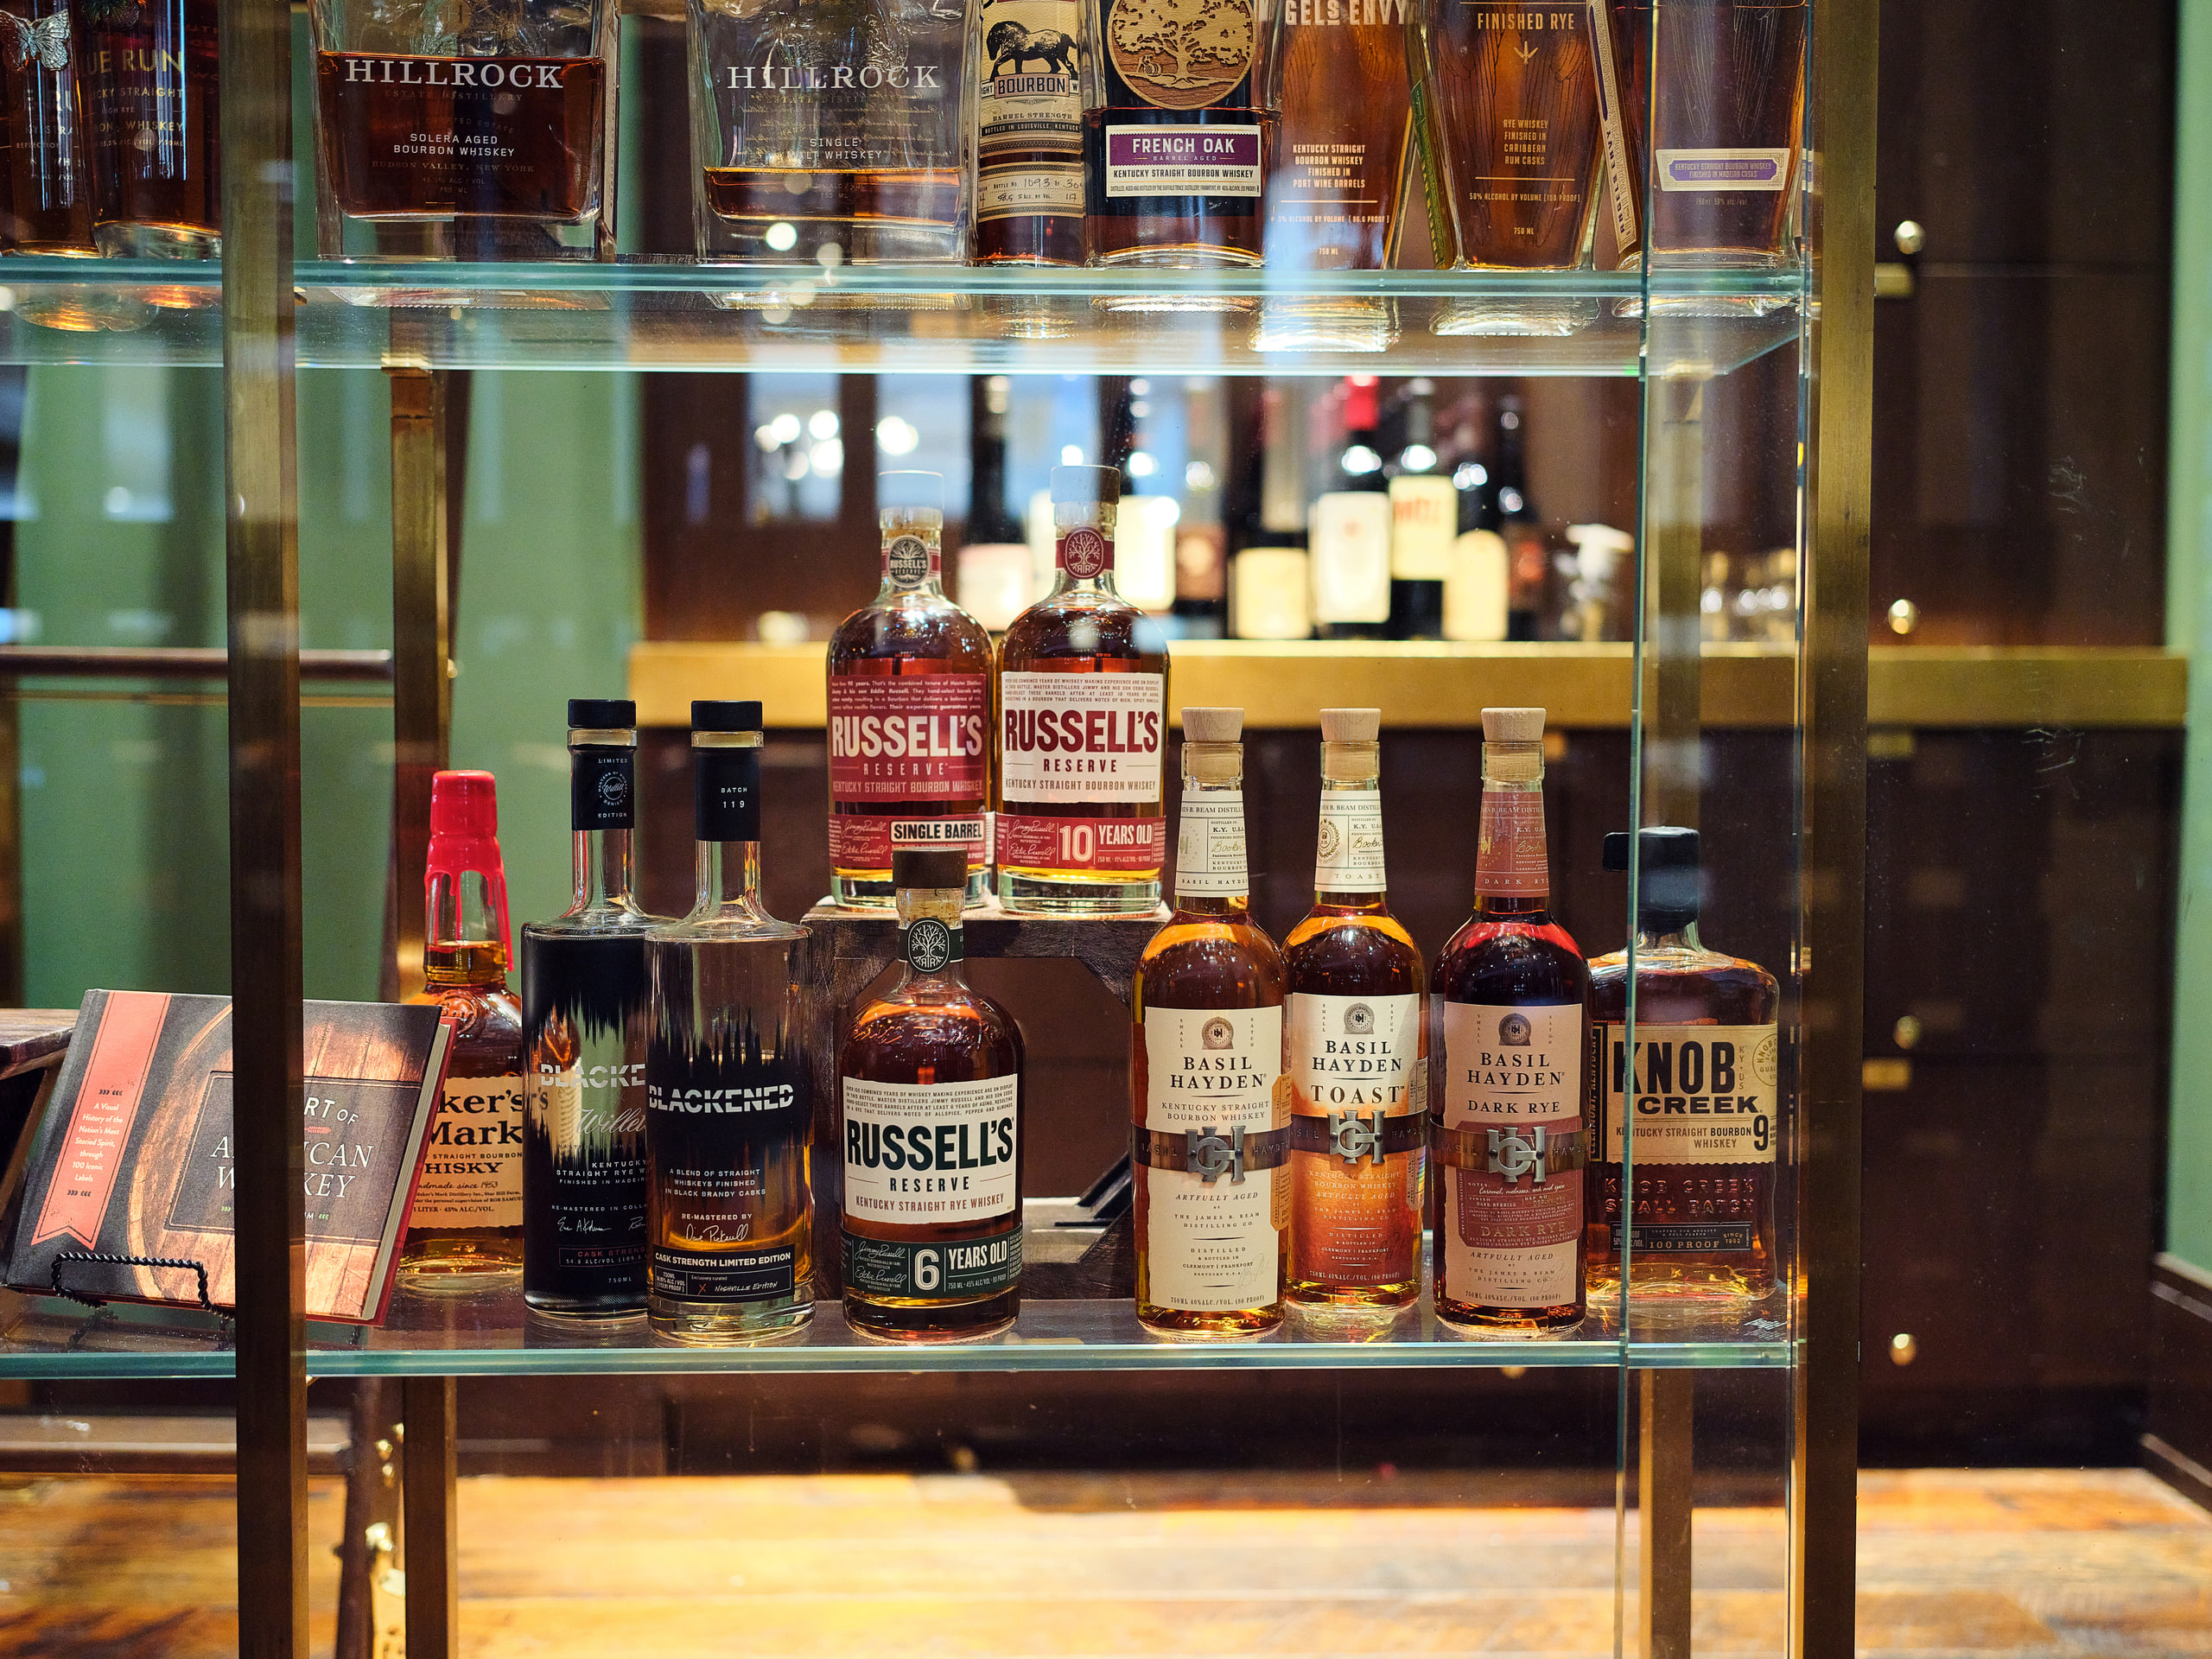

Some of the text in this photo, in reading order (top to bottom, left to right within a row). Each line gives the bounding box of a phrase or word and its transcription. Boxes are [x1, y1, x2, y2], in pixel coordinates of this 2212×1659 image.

[1350, 0, 1408, 25] ENVY
[1478, 13, 1574, 30] FINISHED RYE
[122, 49, 183, 73] RUN
[345, 60, 563, 88] HILLROCK
[727, 66, 940, 89] HILLROCK
[998, 77, 1065, 94] BOURBON
[120, 86, 183, 99] STRAIGHT
[993, 113, 1025, 122] BARREL
[1503, 119, 1548, 129] RYE WHISKEY
[125, 121, 183, 131] WHISKEY
[410, 133, 498, 144] SOLERA AGED
[810, 138, 858, 147] SINGLE
[1504, 131, 1547, 141] FINISHED IN
[394, 145, 514, 156] BOURBON WHISKEY
[1132, 138, 1235, 154] FRENCH OAK
[1293, 144, 1366, 154] KENTUCKY STRAIGHT
[1503, 143, 1547, 153] CARIBBEAN
[1605, 130, 1616, 170] ENVY
[825, 149, 882, 160] WHISKEY
[1295, 156, 1363, 165] BOURBON WHISKEY
[1504, 156, 1545, 165] RUM CASKS
[1114, 168, 1254, 178] KENTUCKY STRAIGHT BOURBON WHISKEY
[1307, 168, 1351, 176] FINISHED IN
[1293, 179, 1366, 188] PORT WINE BARRELS
[890, 559, 926, 569] RUSSELL'S
[832, 715, 982, 758] RUSSELL'S
[1006, 709, 1159, 753] RUSSELL'S
[863, 763, 944, 776] RESERVE
[1043, 759, 1117, 772] RESERVE
[833, 780, 983, 793] KENTUCKY STRAIGHT BOURBON WHISKEY
[1006, 779, 1156, 791] KENTUCKY STRAIGHT BOURBON WHISKEY
[893, 823, 982, 840] SINGLE BARREL
[1098, 824, 1135, 845] YEARS
[1136, 824, 1152, 844] OLD
[1059, 824, 1094, 861] 10
[1325, 1039, 1391, 1054] BASIL
[1184, 1057, 1252, 1071] BASIL
[1312, 1057, 1402, 1072] HAYDEN
[1480, 1052, 1550, 1068] BASIL
[1613, 1040, 1735, 1095] KNOB
[1170, 1073, 1264, 1090] HAYDEN
[1466, 1070, 1561, 1086] HAYDEN
[649, 1084, 794, 1113] BLACKENED
[1161, 1101, 1270, 1111] KENTUCKY STRAIGHT
[1467, 1099, 1560, 1114] DARK RYE
[1637, 1096, 1759, 1115] CREEK
[82, 1114, 105, 1124] History
[336, 1109, 359, 1125] OF
[1167, 1111, 1266, 1122] BOURBON WHISKEY
[1665, 1128, 1707, 1137] STRAIGHT
[1710, 1127, 1751, 1137] BOURBON
[1753, 1115, 1769, 1151] 9
[74, 1137, 97, 1146] Storied
[847, 1117, 1014, 1171] RUSSELL'S
[1694, 1139, 1737, 1148] WHISKEY
[79, 1150, 104, 1160] through
[592, 1160, 647, 1168] KENTUCKY
[74, 1173, 93, 1182] Labels
[676, 1168, 701, 1177] BLEND
[718, 1168, 760, 1177] STRAIGHT
[890, 1176, 969, 1192] RESERVE
[855, 1192, 1005, 1212] KENTUCKY STRAIGHT RYE WHISKEY
[1233, 1192, 1259, 1200] AGED
[1480, 1221, 1565, 1237] DARK RYE
[1677, 1240, 1720, 1249] PROOF
[655, 1252, 791, 1268] CASK STRENGTH LIMITED EDITION
[948, 1244, 988, 1270] YEARS
[989, 1240, 1007, 1264] OLD
[914, 1249, 940, 1291] 6
